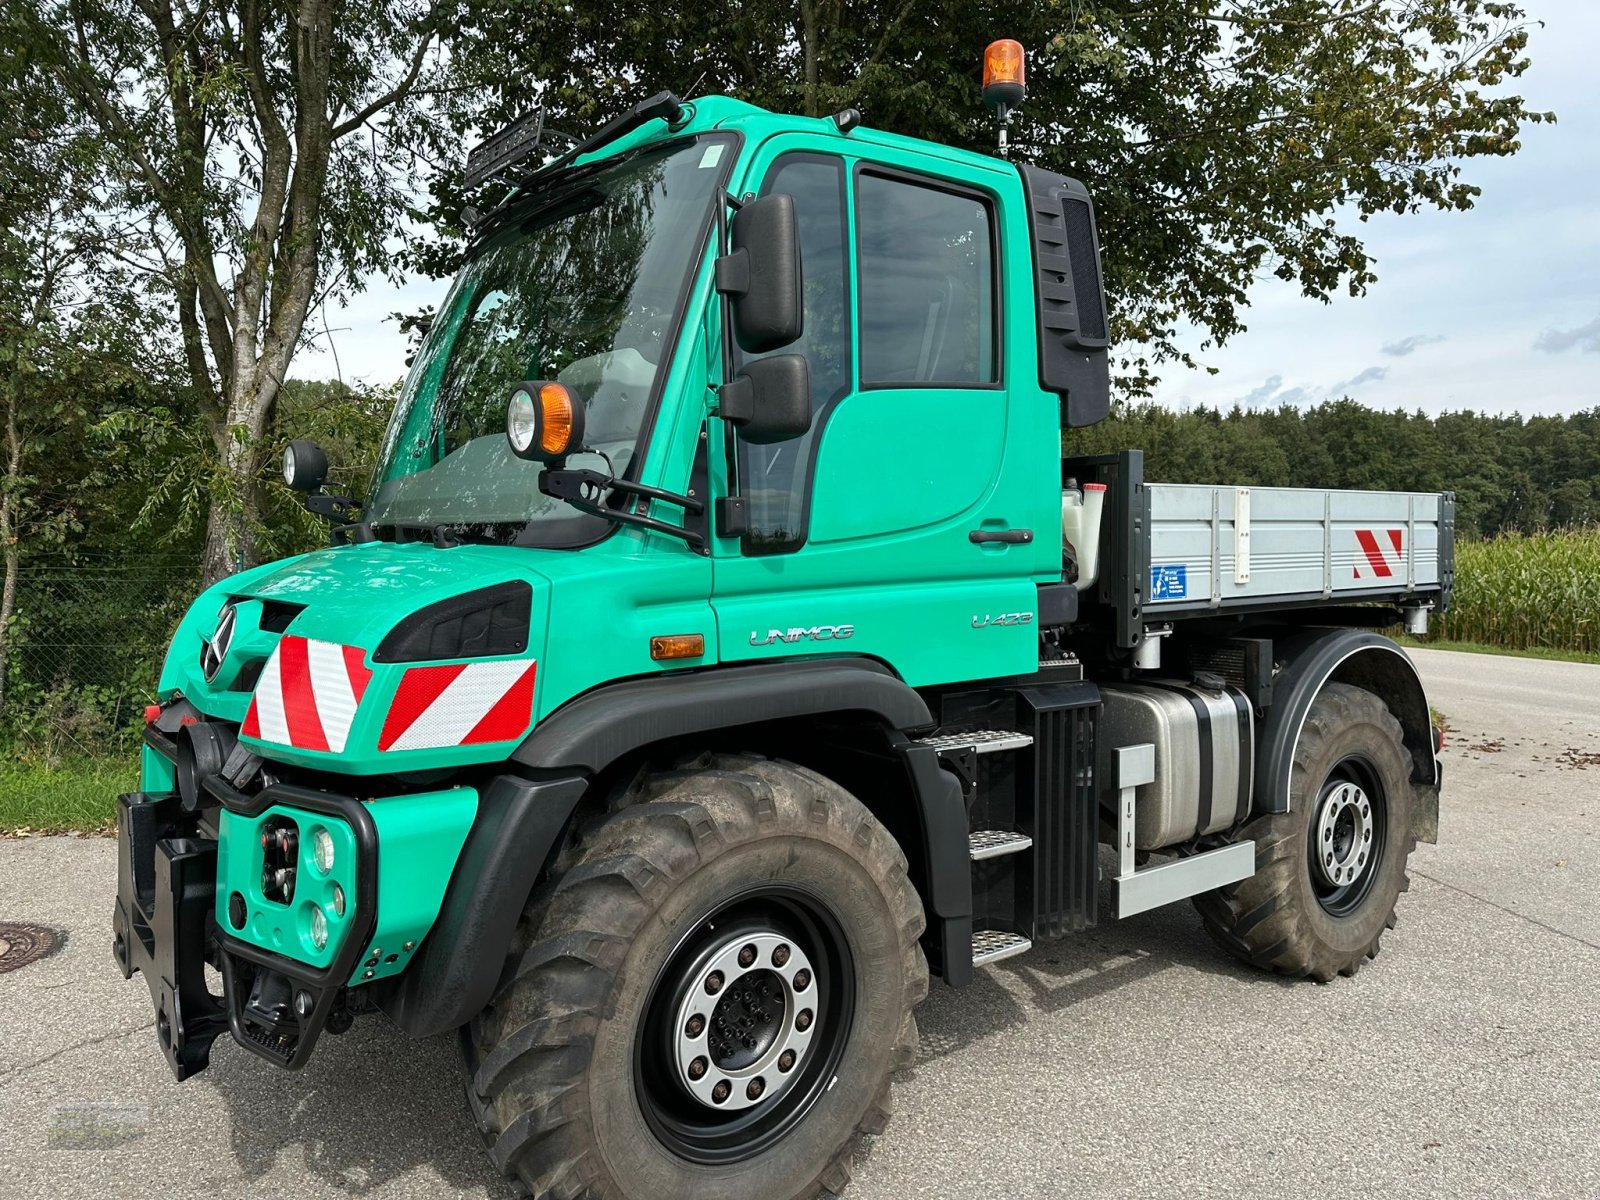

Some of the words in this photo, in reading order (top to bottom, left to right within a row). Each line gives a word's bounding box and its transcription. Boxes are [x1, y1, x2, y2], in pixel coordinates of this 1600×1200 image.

[972, 615, 989, 628] U
[991, 612, 1033, 626] 423
[750, 624, 854, 646] UNIMOG
